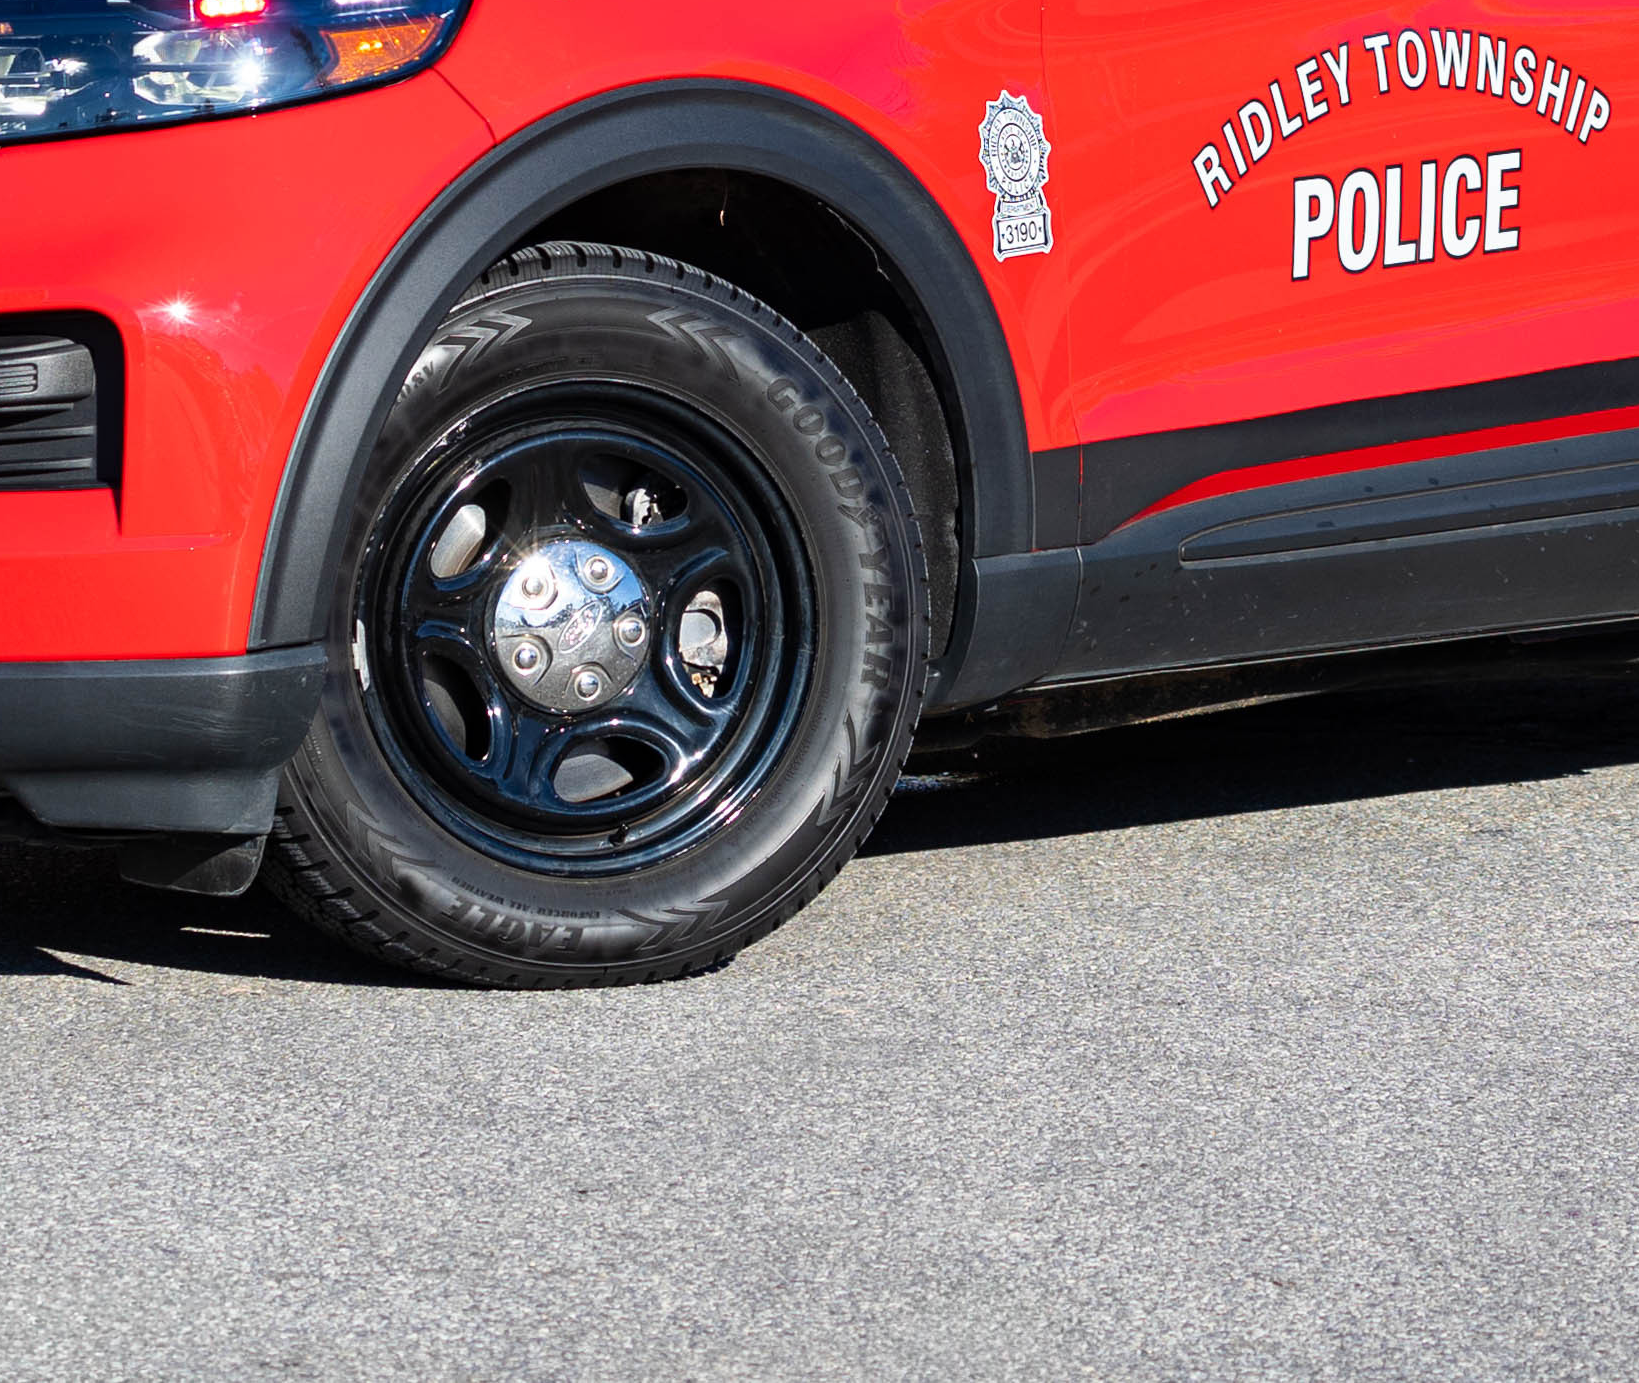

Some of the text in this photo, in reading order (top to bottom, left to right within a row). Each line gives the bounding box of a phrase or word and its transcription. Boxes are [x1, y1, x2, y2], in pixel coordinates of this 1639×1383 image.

[1193, 29, 1611, 207] RIDLEY TOWNSHIP
[1005, 221, 1037, 244] 3190
[1292, 152, 1521, 279] POLICE
[767, 378, 893, 689] GOODYEAR
[440, 894, 584, 954] EAGLE
